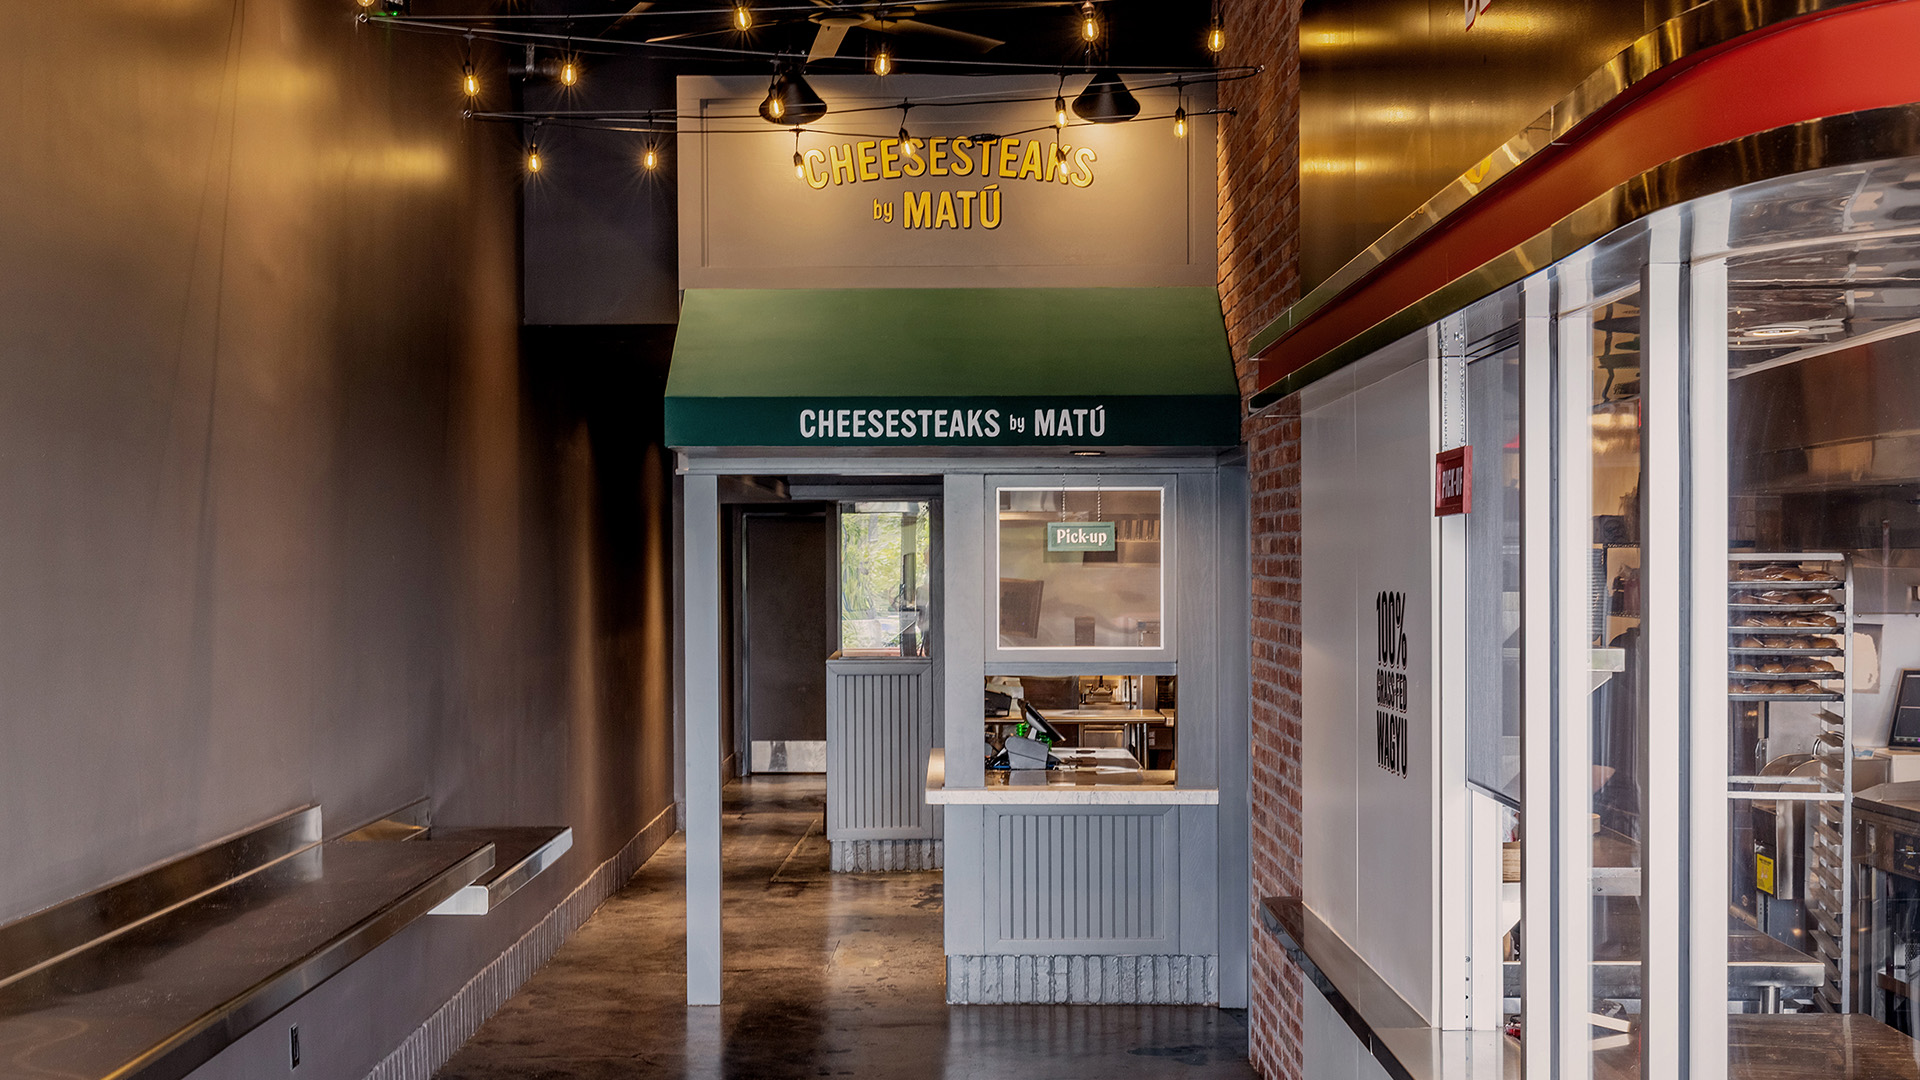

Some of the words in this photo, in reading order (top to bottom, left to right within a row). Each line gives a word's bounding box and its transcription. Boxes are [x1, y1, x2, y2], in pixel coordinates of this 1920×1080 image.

[802, 135, 1098, 189] CHEESESTEAKS
[872, 198, 894, 224] by
[903, 184, 1001, 230] MATÚ
[799, 408, 1001, 438] CHEESESTEAKS
[1008, 413, 1026, 434] by
[1033, 404, 1106, 437] MATÚ
[1056, 527, 1108, 547] Pick-up
[1375, 590, 1408, 669] 100%
[1376, 709, 1408, 779] WAGYU
